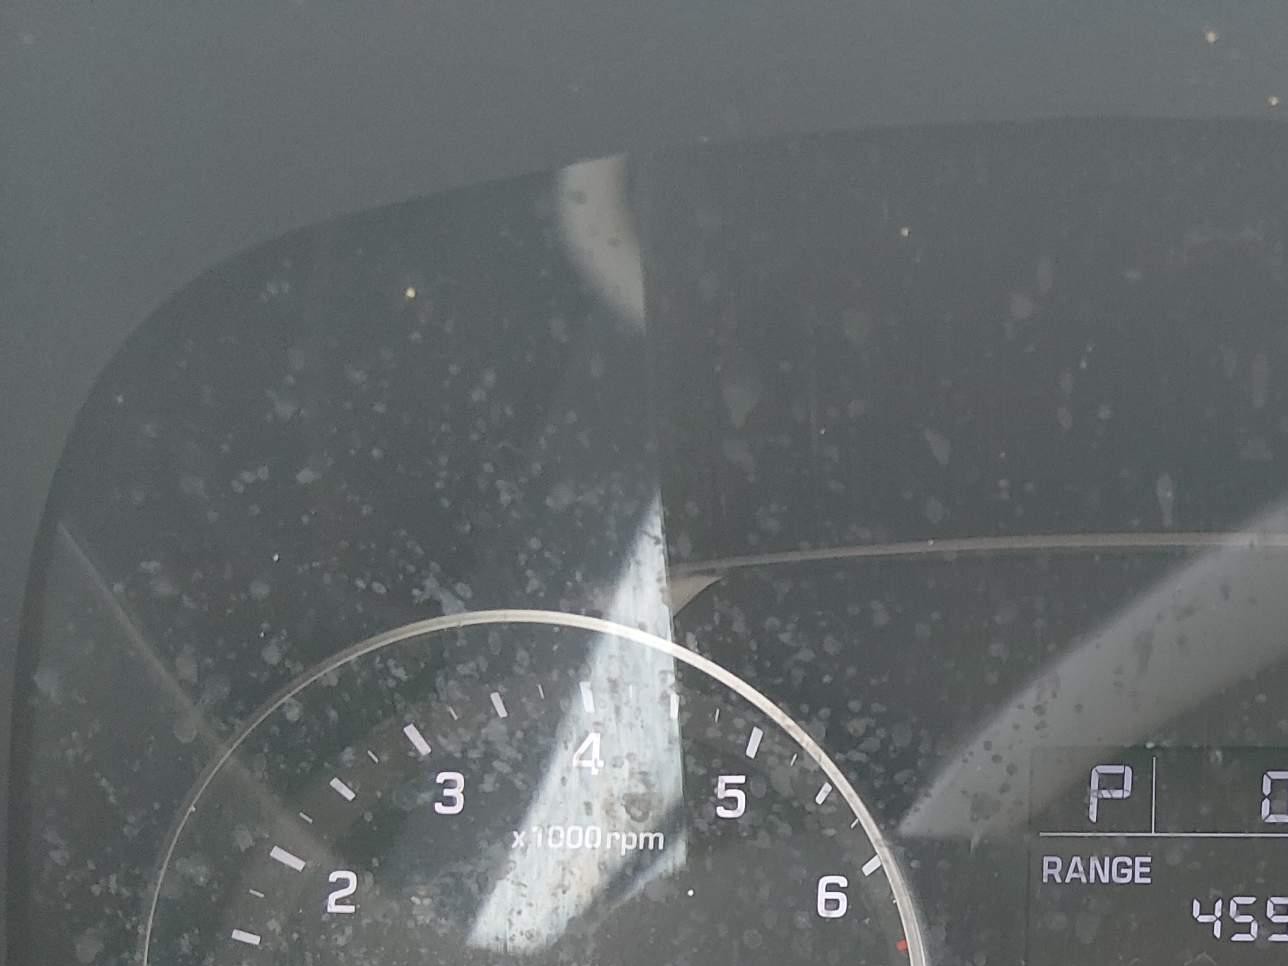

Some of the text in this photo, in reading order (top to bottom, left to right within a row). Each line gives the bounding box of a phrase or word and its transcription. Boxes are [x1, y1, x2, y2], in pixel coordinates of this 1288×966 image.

[572, 732, 603, 775] 4
[434, 772, 465, 814] 3
[716, 776, 746, 818] 5
[1089, 765, 1133, 823] P
[606, 831, 665, 856] rpm
[1043, 856, 1152, 884] RANGE
[327, 870, 357, 913] 2
[817, 876, 848, 918] 6
